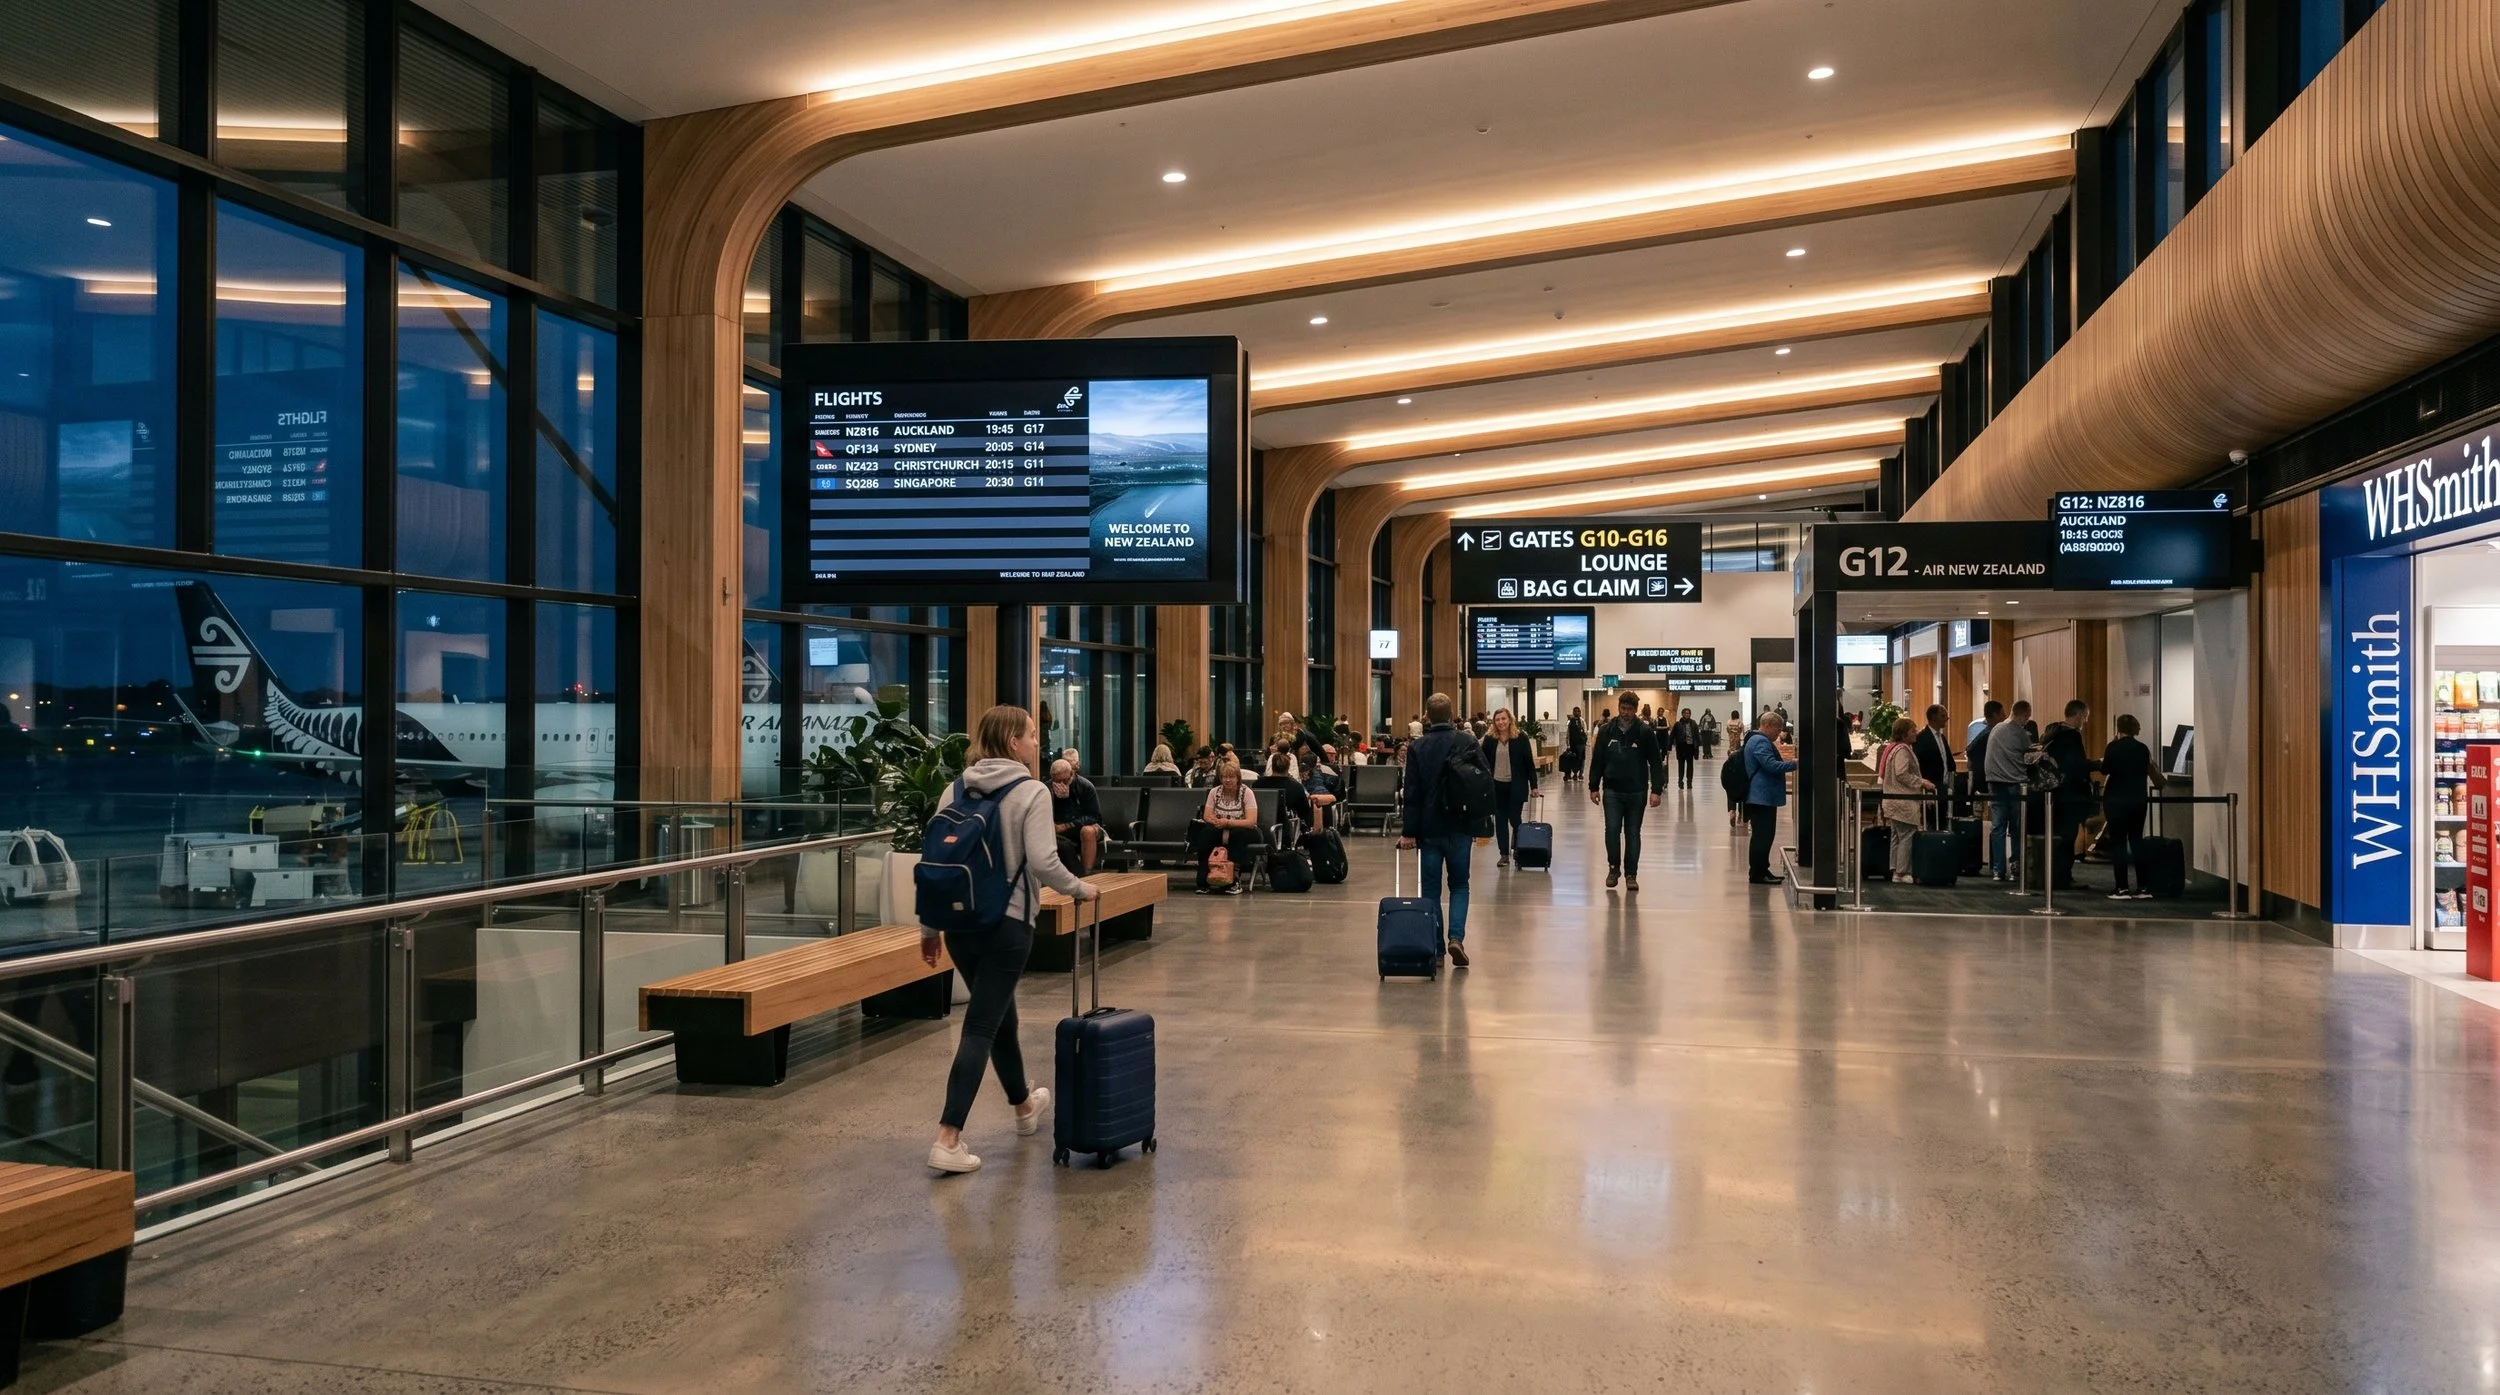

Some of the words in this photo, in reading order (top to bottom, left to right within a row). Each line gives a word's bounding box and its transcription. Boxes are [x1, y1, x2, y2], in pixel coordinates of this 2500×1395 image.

[814, 391, 883, 407] FLIGHTS
[845, 426, 880, 437] NZ816
[893, 425, 955, 436] AUCKLAND
[985, 424, 1014, 434] 19:45
[1023, 423, 1045, 434] G17
[845, 444, 879, 455] QF134
[894, 443, 937, 453] SYDNEY
[985, 441, 1014, 452] 20:05
[1023, 440, 1045, 452] G14
[845, 461, 879, 472] NZ423
[894, 459, 980, 471] CHRISTCHURCH
[985, 459, 1014, 470] 20:15
[1023, 458, 1044, 469] G11
[845, 478, 880, 491] SQ286
[894, 477, 957, 488] SINGAPORE
[985, 477, 1014, 488] 20:30
[2363, 435, 2500, 541] WHSmith
[2059, 496, 2093, 510] G12:
[2097, 495, 2145, 509] NZ816
[1109, 523, 1172, 534] WELCOME
[1173, 523, 1190, 534] TO
[2059, 515, 2127, 527] AUCKLAND
[1104, 536, 1134, 548] NEW
[1135, 536, 1195, 547] ZEALAND
[1509, 530, 1575, 549] GATES
[1580, 528, 1668, 548] G10-G16
[1581, 553, 1668, 572] LOUNGE
[1839, 546, 1909, 577] G12
[1922, 564, 1945, 576] AIR
[1948, 564, 1980, 576] NEW
[1982, 563, 2046, 575] ZEALAND
[1523, 579, 1567, 597] BAG
[1573, 578, 1640, 597] CLAIM
[2352, 611, 2402, 870] WHSmith
